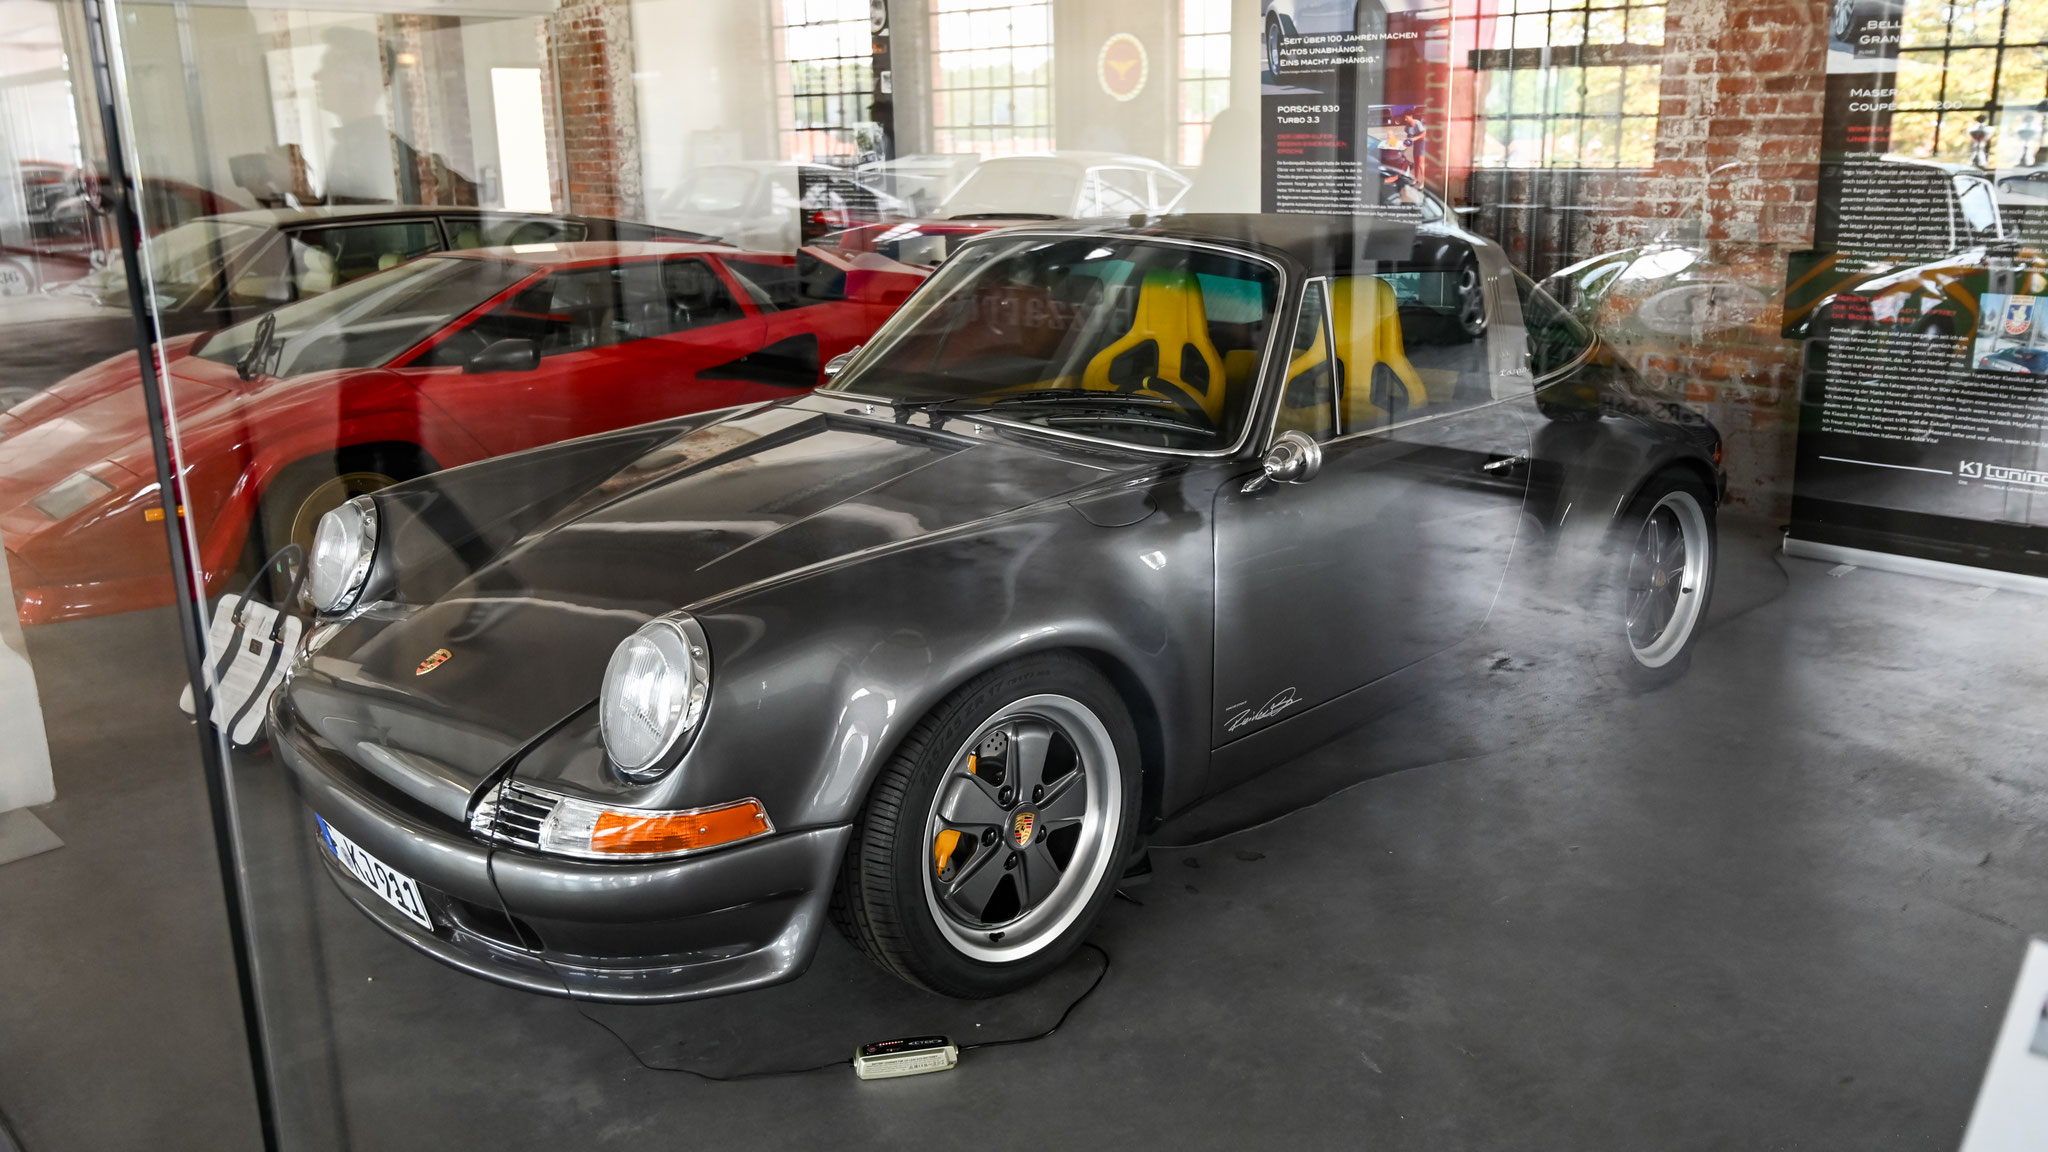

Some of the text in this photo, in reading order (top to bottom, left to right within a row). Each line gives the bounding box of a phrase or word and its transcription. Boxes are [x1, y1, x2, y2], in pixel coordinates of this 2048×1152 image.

[1860, 20, 1903, 32] „BELL
[1280, 32, 1418, 46] „SEIT ÜBER 100 JAHREN MACHEN
[1309, 46, 1366, 54] UNABHÄNGIG.
[1959, 460, 1983, 478] KJ
